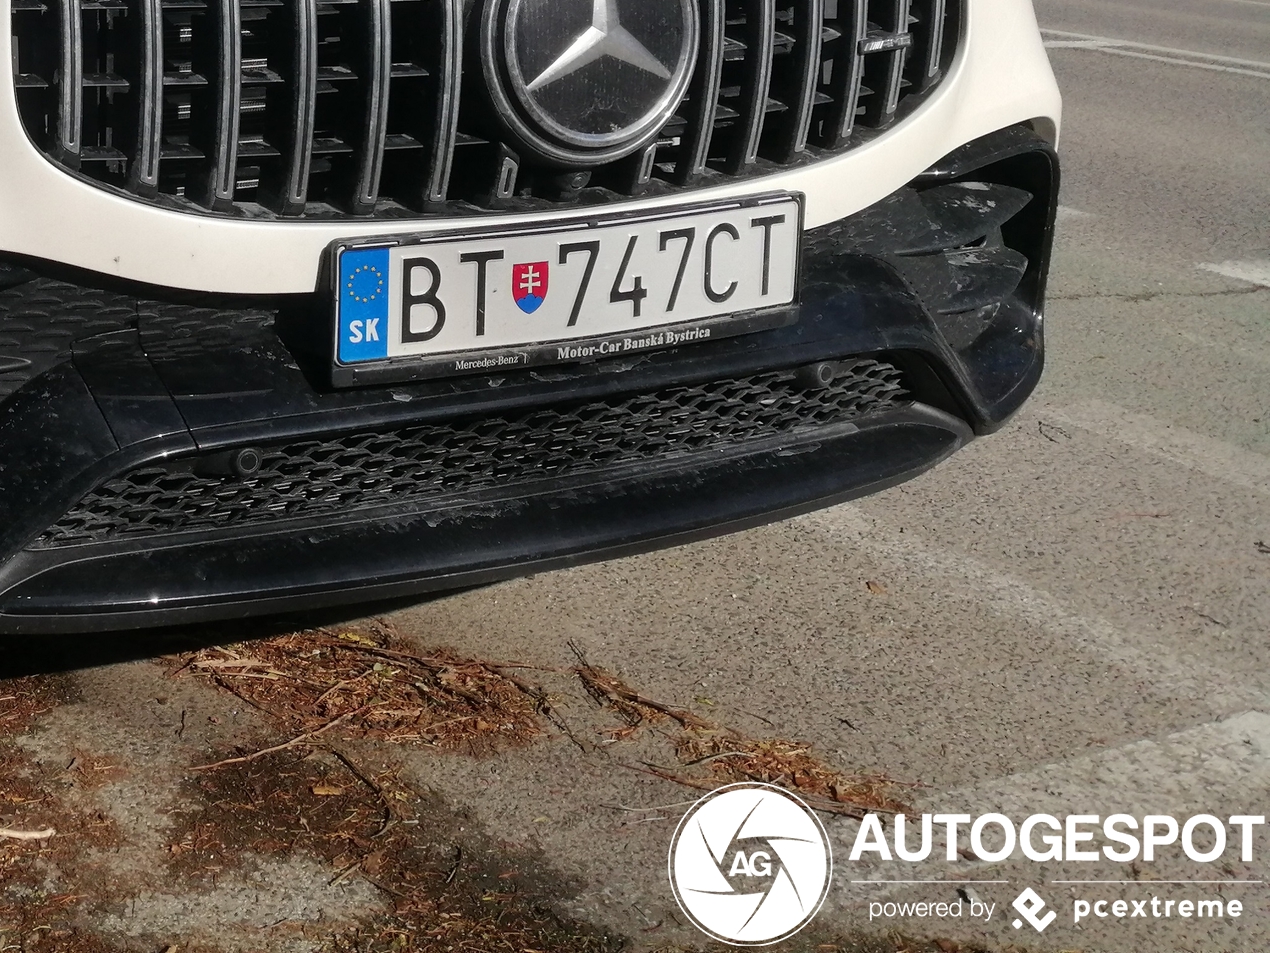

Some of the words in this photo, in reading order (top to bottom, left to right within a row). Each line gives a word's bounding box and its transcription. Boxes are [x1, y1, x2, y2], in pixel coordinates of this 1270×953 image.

[401, 249, 504, 344] BT
[558, 214, 786, 327] 747CT
[349, 318, 379, 343] SK
[557, 341, 622, 360] Motor-Car
[623, 334, 664, 351] Banská
[666, 328, 711, 346] Bystrica
[455, 355, 519, 371] Mercedes-Benz
